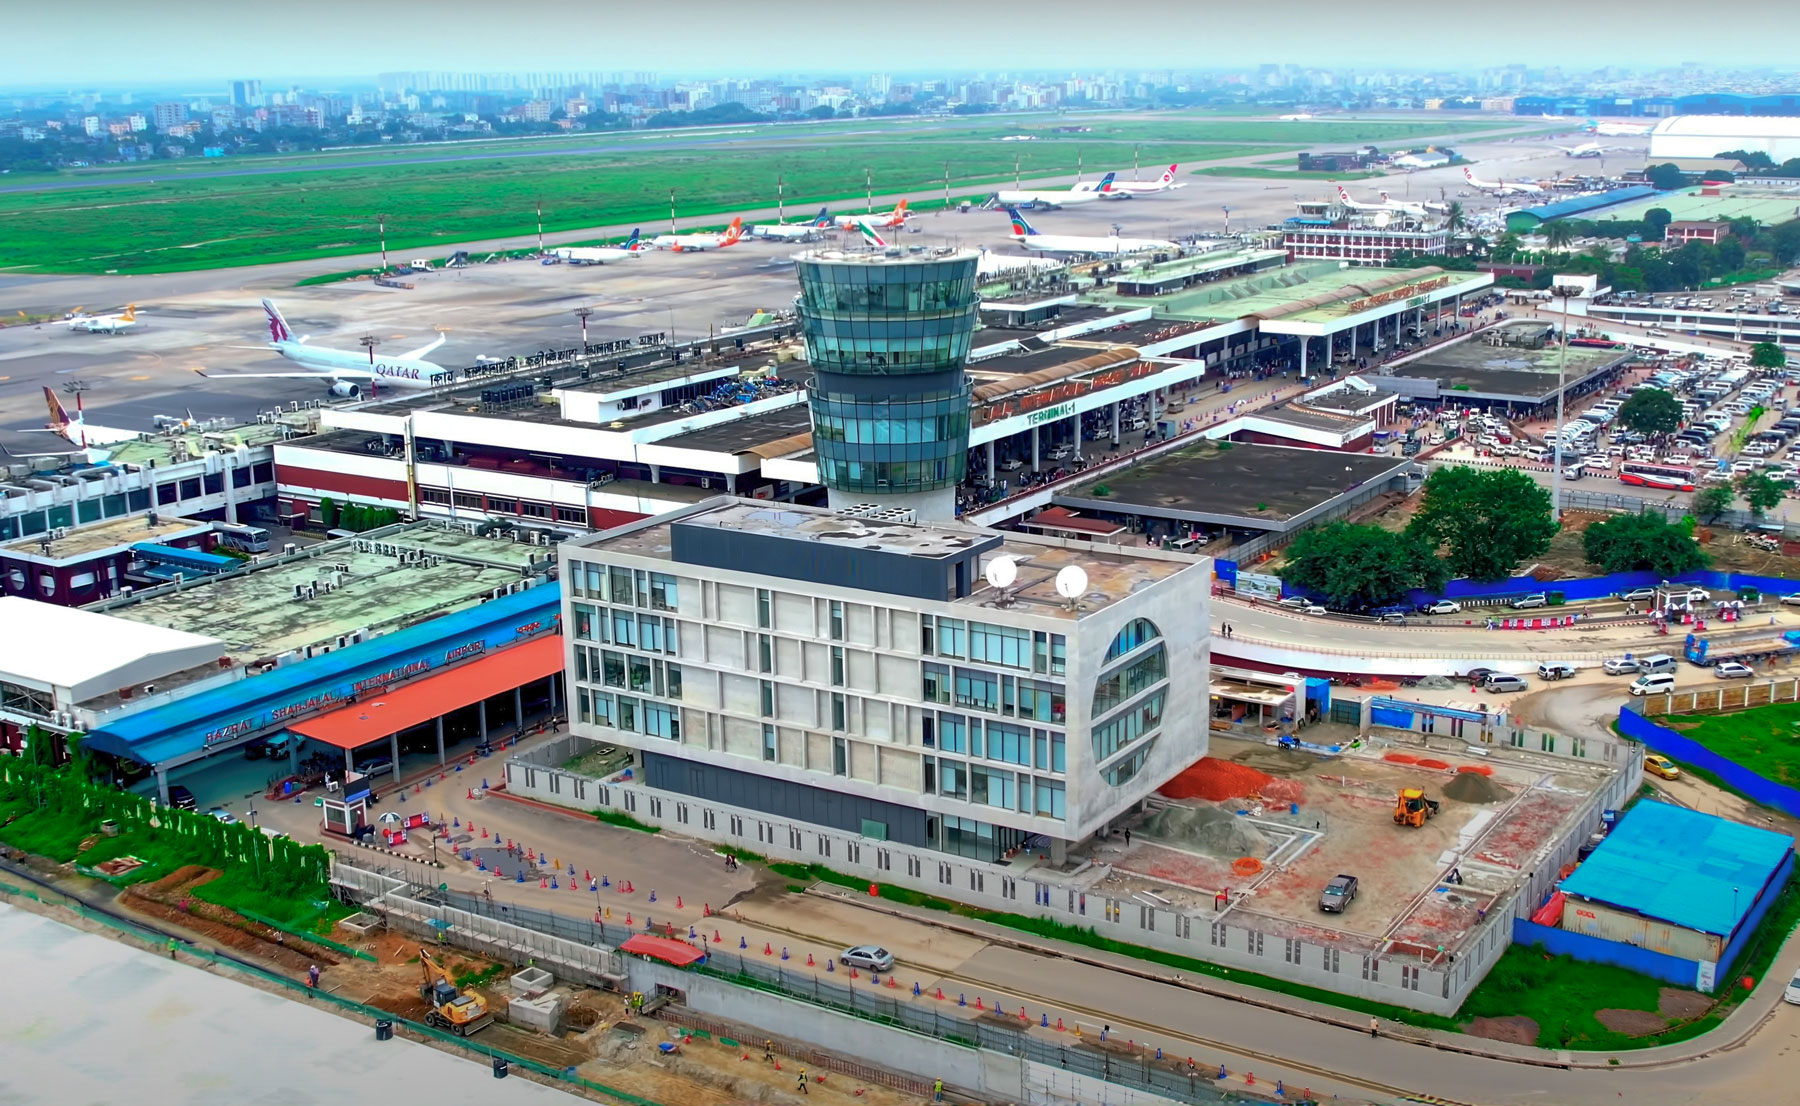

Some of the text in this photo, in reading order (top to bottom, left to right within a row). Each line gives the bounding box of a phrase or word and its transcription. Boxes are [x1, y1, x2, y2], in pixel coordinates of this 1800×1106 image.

[375, 363, 420, 380] QATAR
[1027, 402, 1076, 426] TERMINAL-1
[272, 691, 336, 720] SHAHJALAL
[353, 659, 430, 692] INTERNATIONAL
[445, 640, 485, 661] AIRPORT
